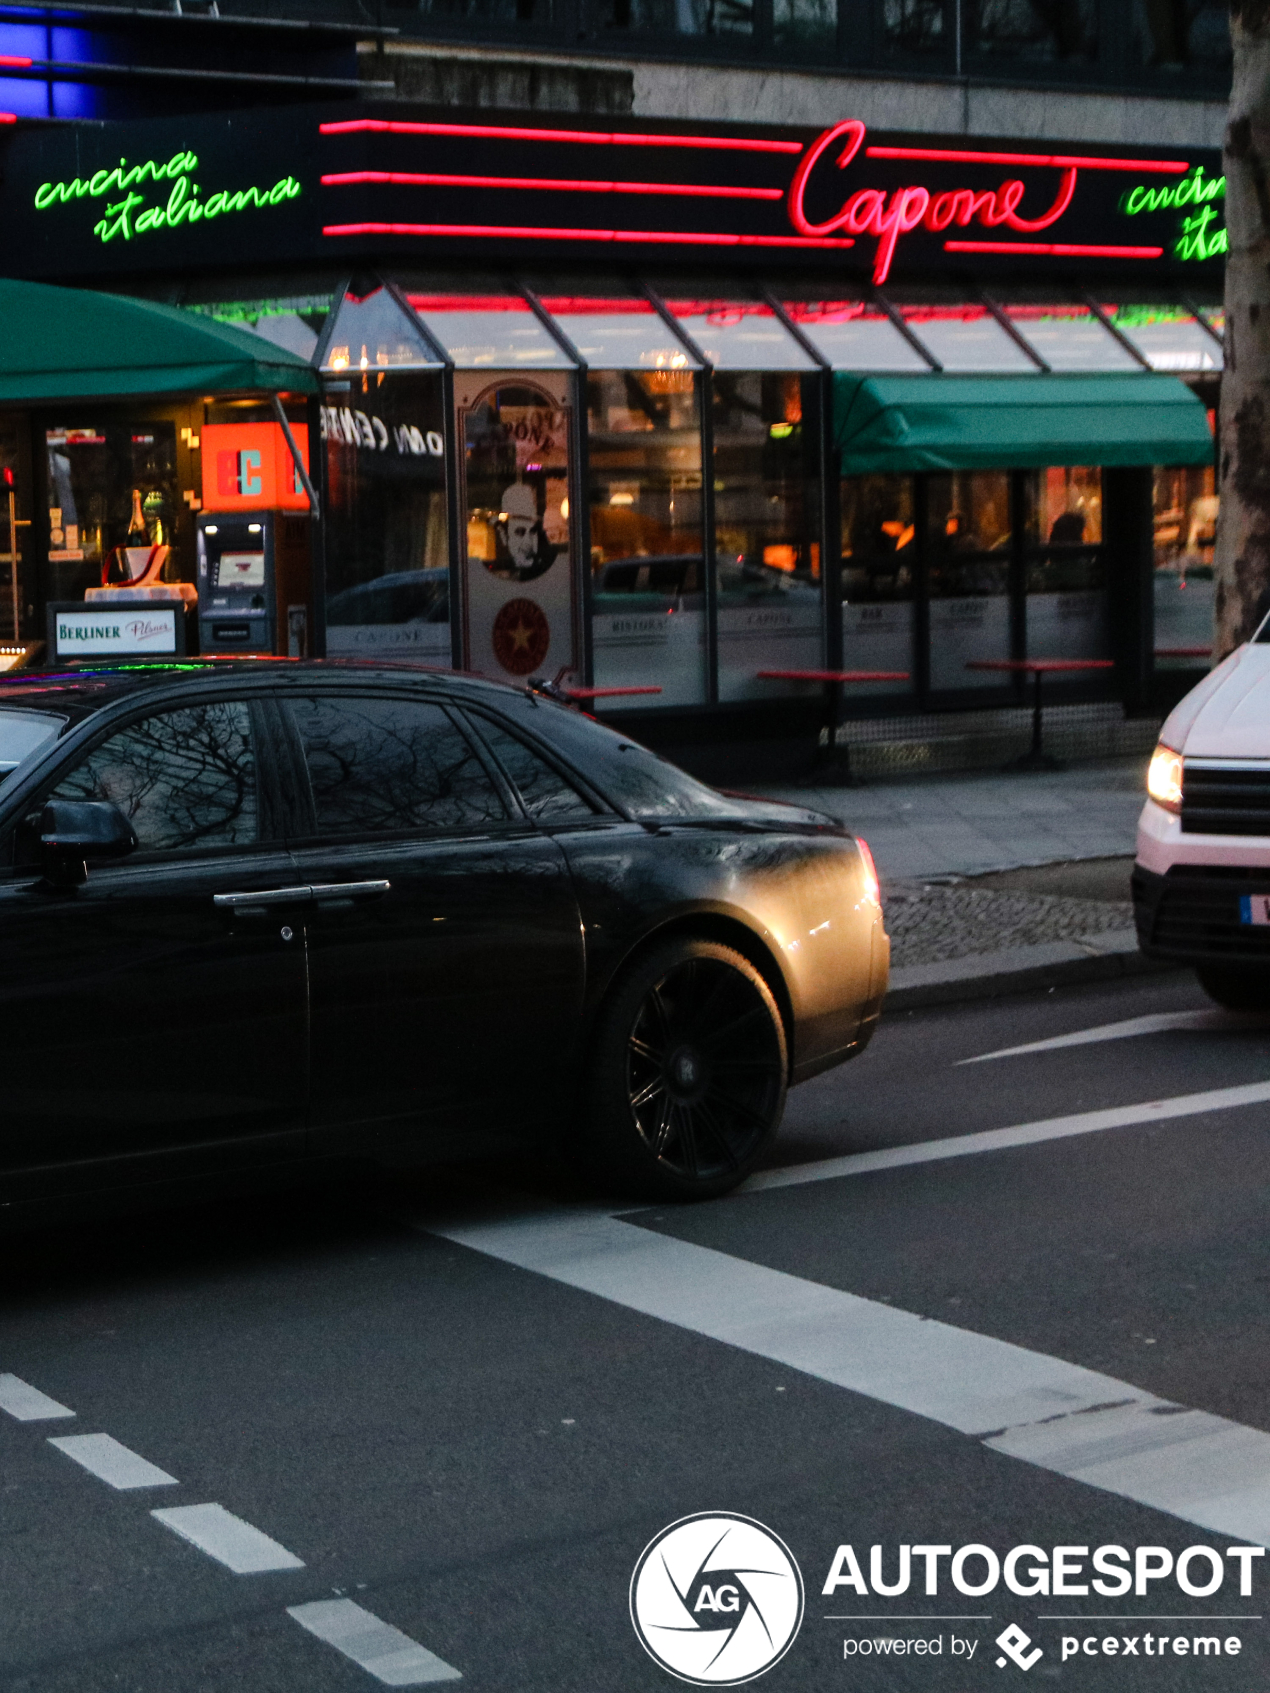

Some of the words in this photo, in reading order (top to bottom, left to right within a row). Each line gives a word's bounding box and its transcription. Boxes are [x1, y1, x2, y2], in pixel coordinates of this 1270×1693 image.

[34, 150, 197, 209] cucina
[93, 176, 301, 242] italiana
[788, 119, 1077, 286] Capone
[58, 624, 121, 641] BERLINER
[125, 620, 173, 641] Pilsner
